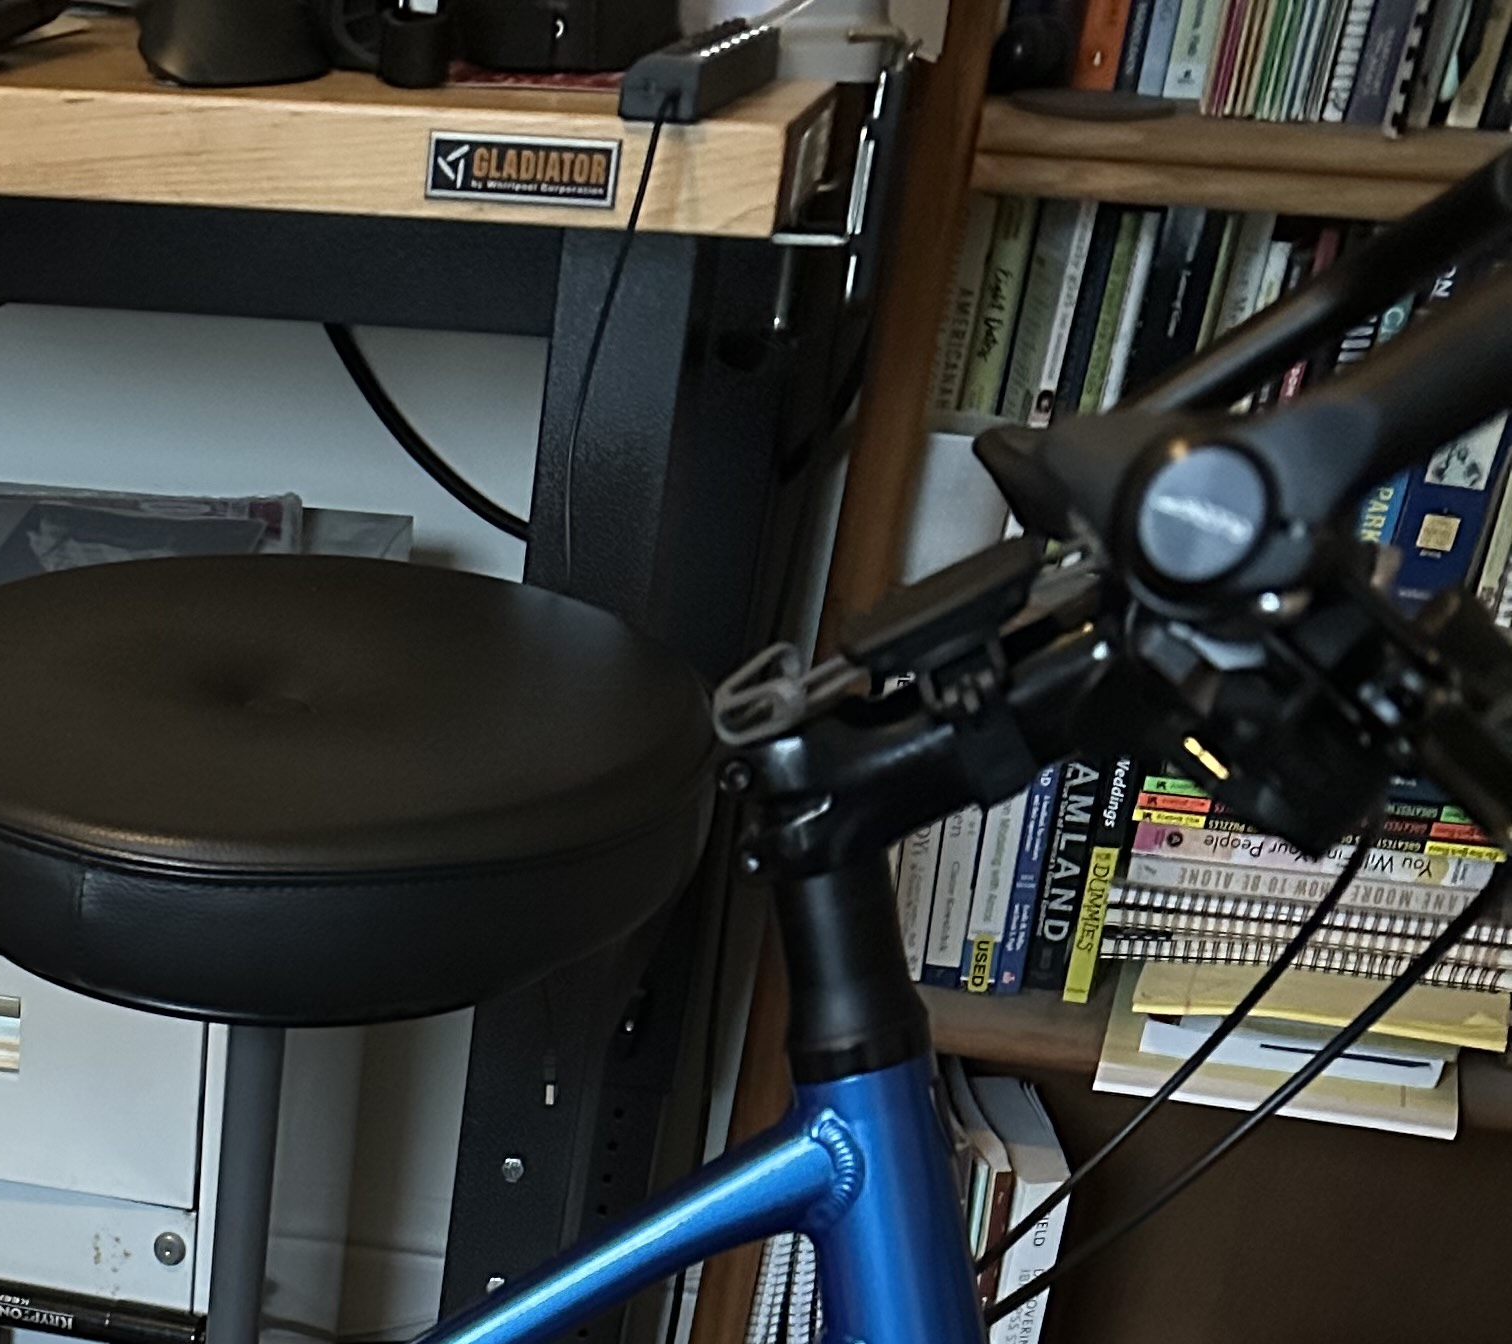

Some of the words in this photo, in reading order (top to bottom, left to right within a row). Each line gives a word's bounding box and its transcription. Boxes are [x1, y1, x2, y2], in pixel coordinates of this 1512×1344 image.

[472, 147, 607, 185] GLADIATOR
[487, 179, 539, 192] Whirlpool
[540, 182, 605, 195] Corporation
[1042, 762, 1100, 944] AMLAND
[1204, 833, 1265, 859] People
[1177, 866, 1235, 890] ALONE
[1402, 856, 1434, 880] You
[1240, 873, 1261, 892] BE
[1268, 875, 1287, 895] TO
[1295, 879, 1332, 900] HOW
[1352, 884, 1415, 908] MOORE
[1075, 864, 1110, 953] DUMMIES
[972, 939, 990, 988] USED
[1033, 1214, 1050, 1247] IELD
